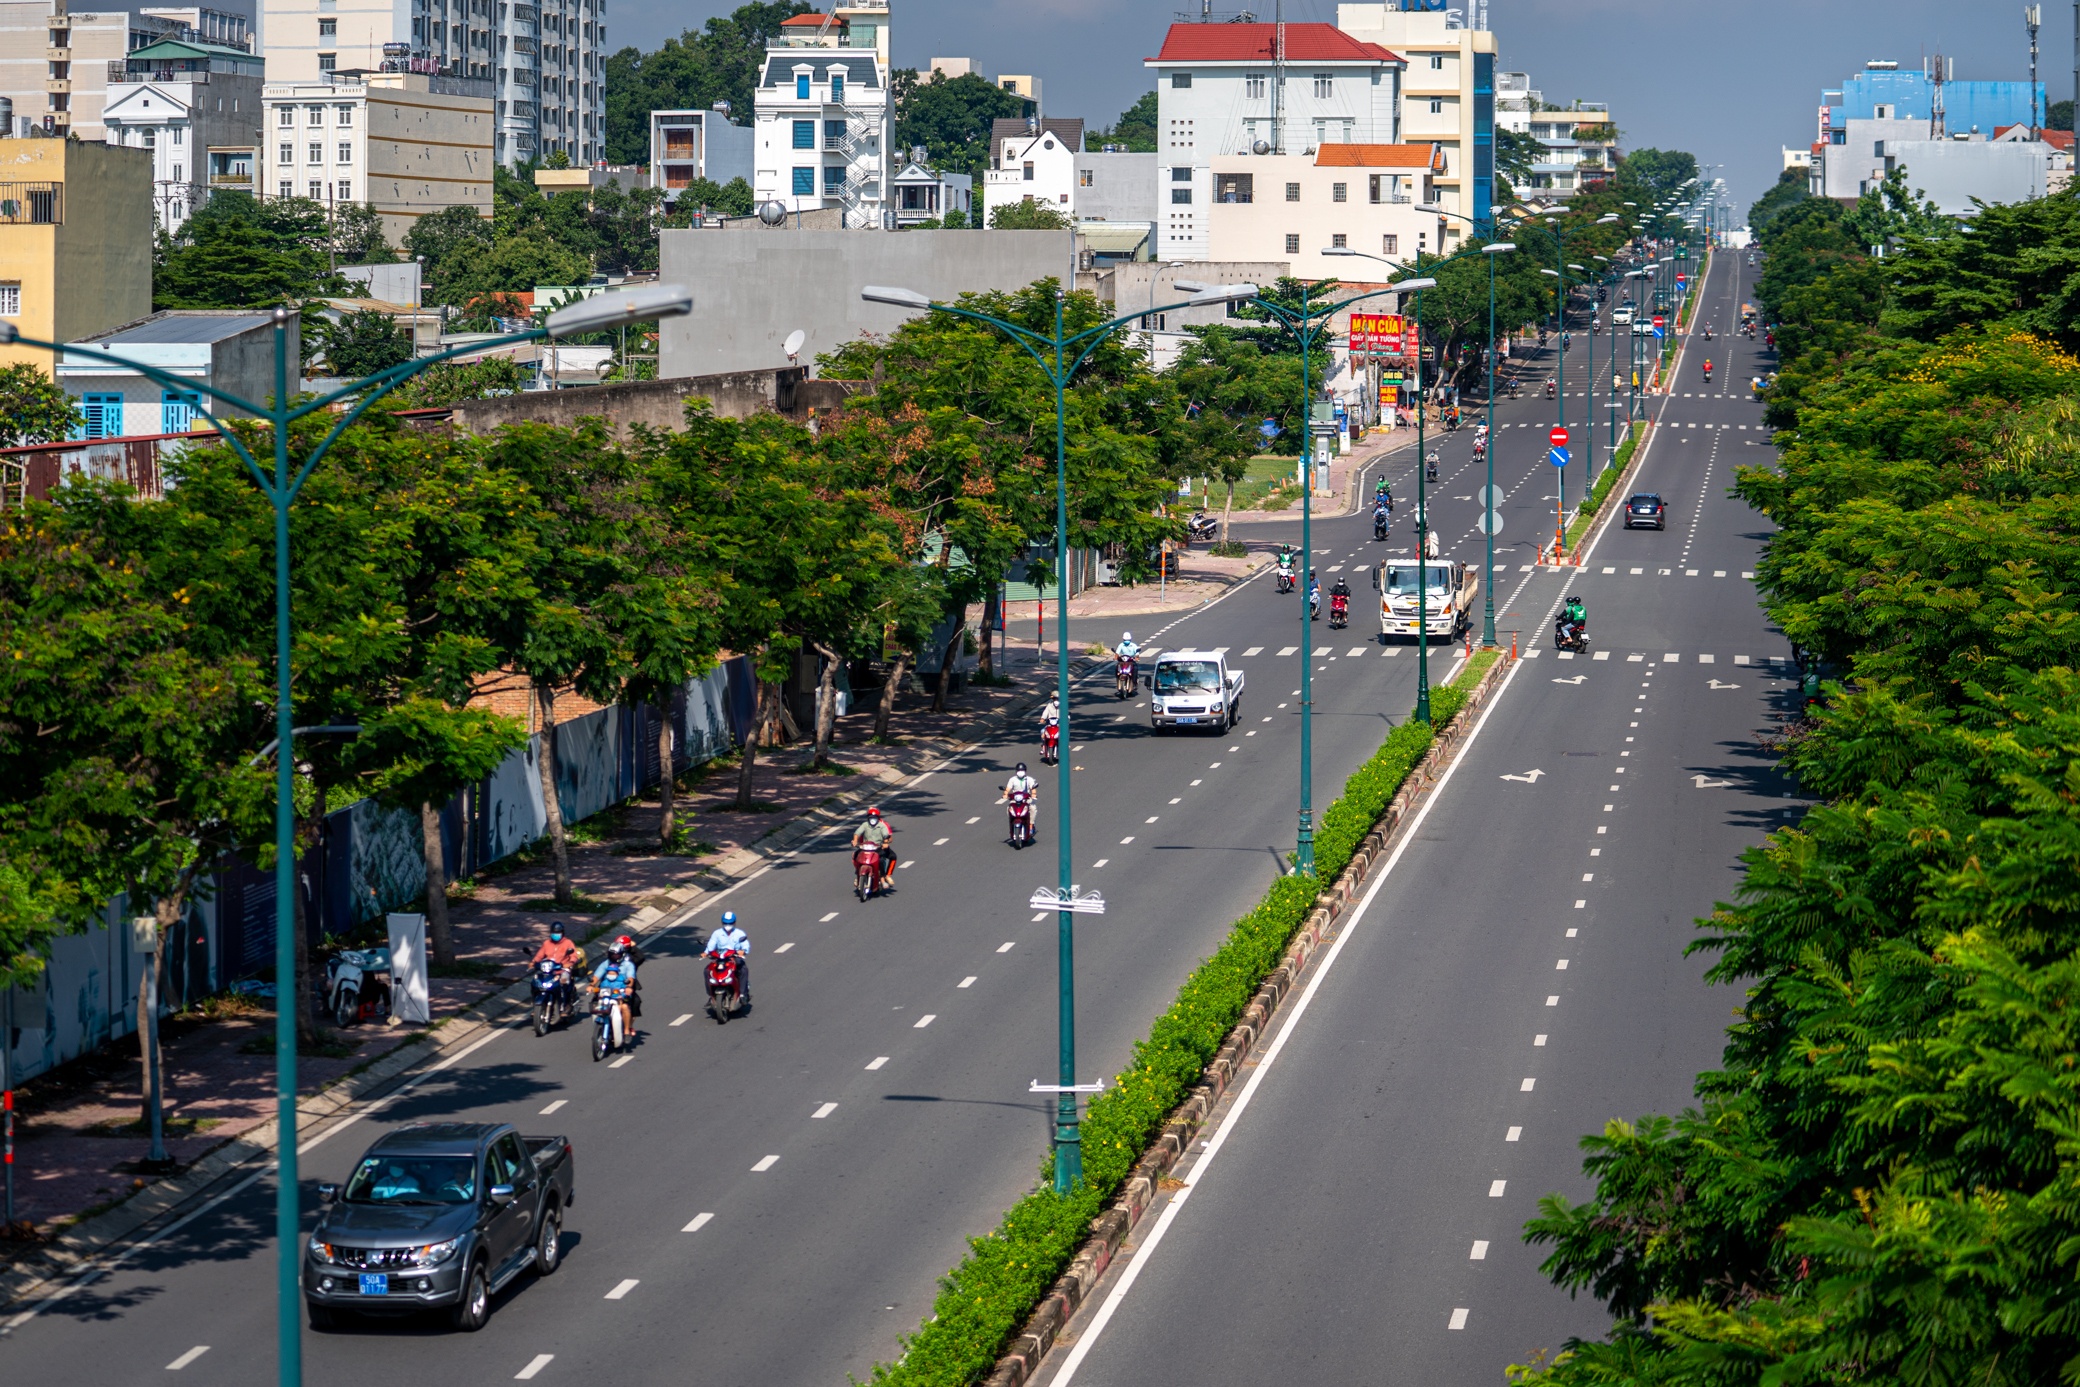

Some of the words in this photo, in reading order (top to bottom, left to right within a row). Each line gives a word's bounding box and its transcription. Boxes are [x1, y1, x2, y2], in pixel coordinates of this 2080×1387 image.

[1352, 316, 1375, 332] MÀN
[1378, 316, 1399, 333] CỬA
[1380, 386, 1397, 394] MÀN
[1381, 394, 1396, 402] CỬA
[365, 1275, 380, 1284] 50A
